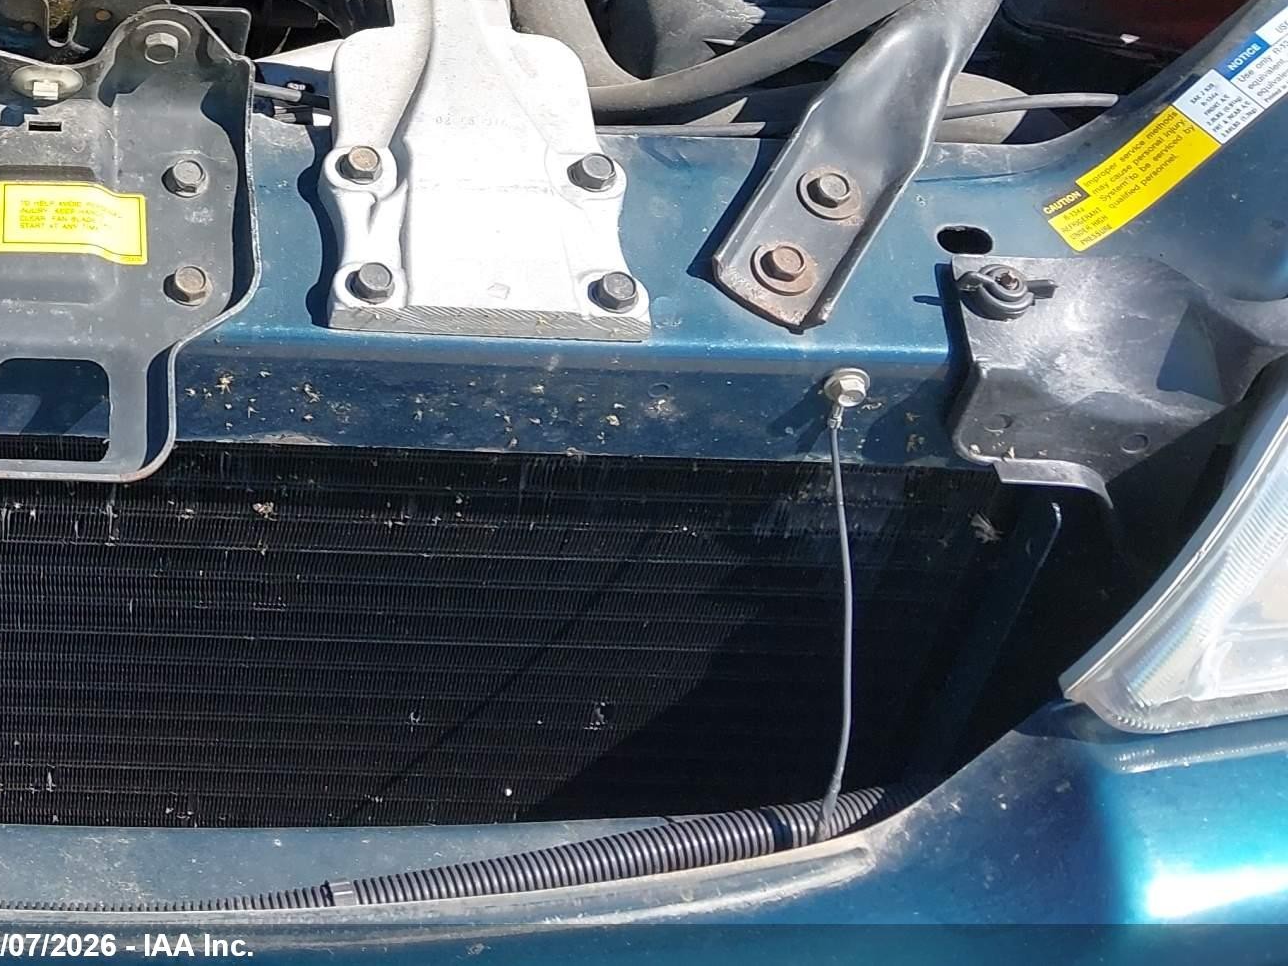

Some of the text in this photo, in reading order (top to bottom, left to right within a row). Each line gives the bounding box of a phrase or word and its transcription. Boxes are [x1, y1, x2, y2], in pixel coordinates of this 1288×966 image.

[1227, 42, 1262, 71] NOTICE
[1083, 110, 1179, 188] Improper service methods
[1092, 182, 1110, 196] may
[1111, 164, 1132, 183] cause
[1132, 137, 1163, 167] personal
[1139, 162, 1152, 173] be
[1153, 134, 1183, 163] serviced
[1183, 123, 1196, 136] by
[1042, 190, 1082, 215] CAUTION
[1108, 183, 1142, 210] qualified
